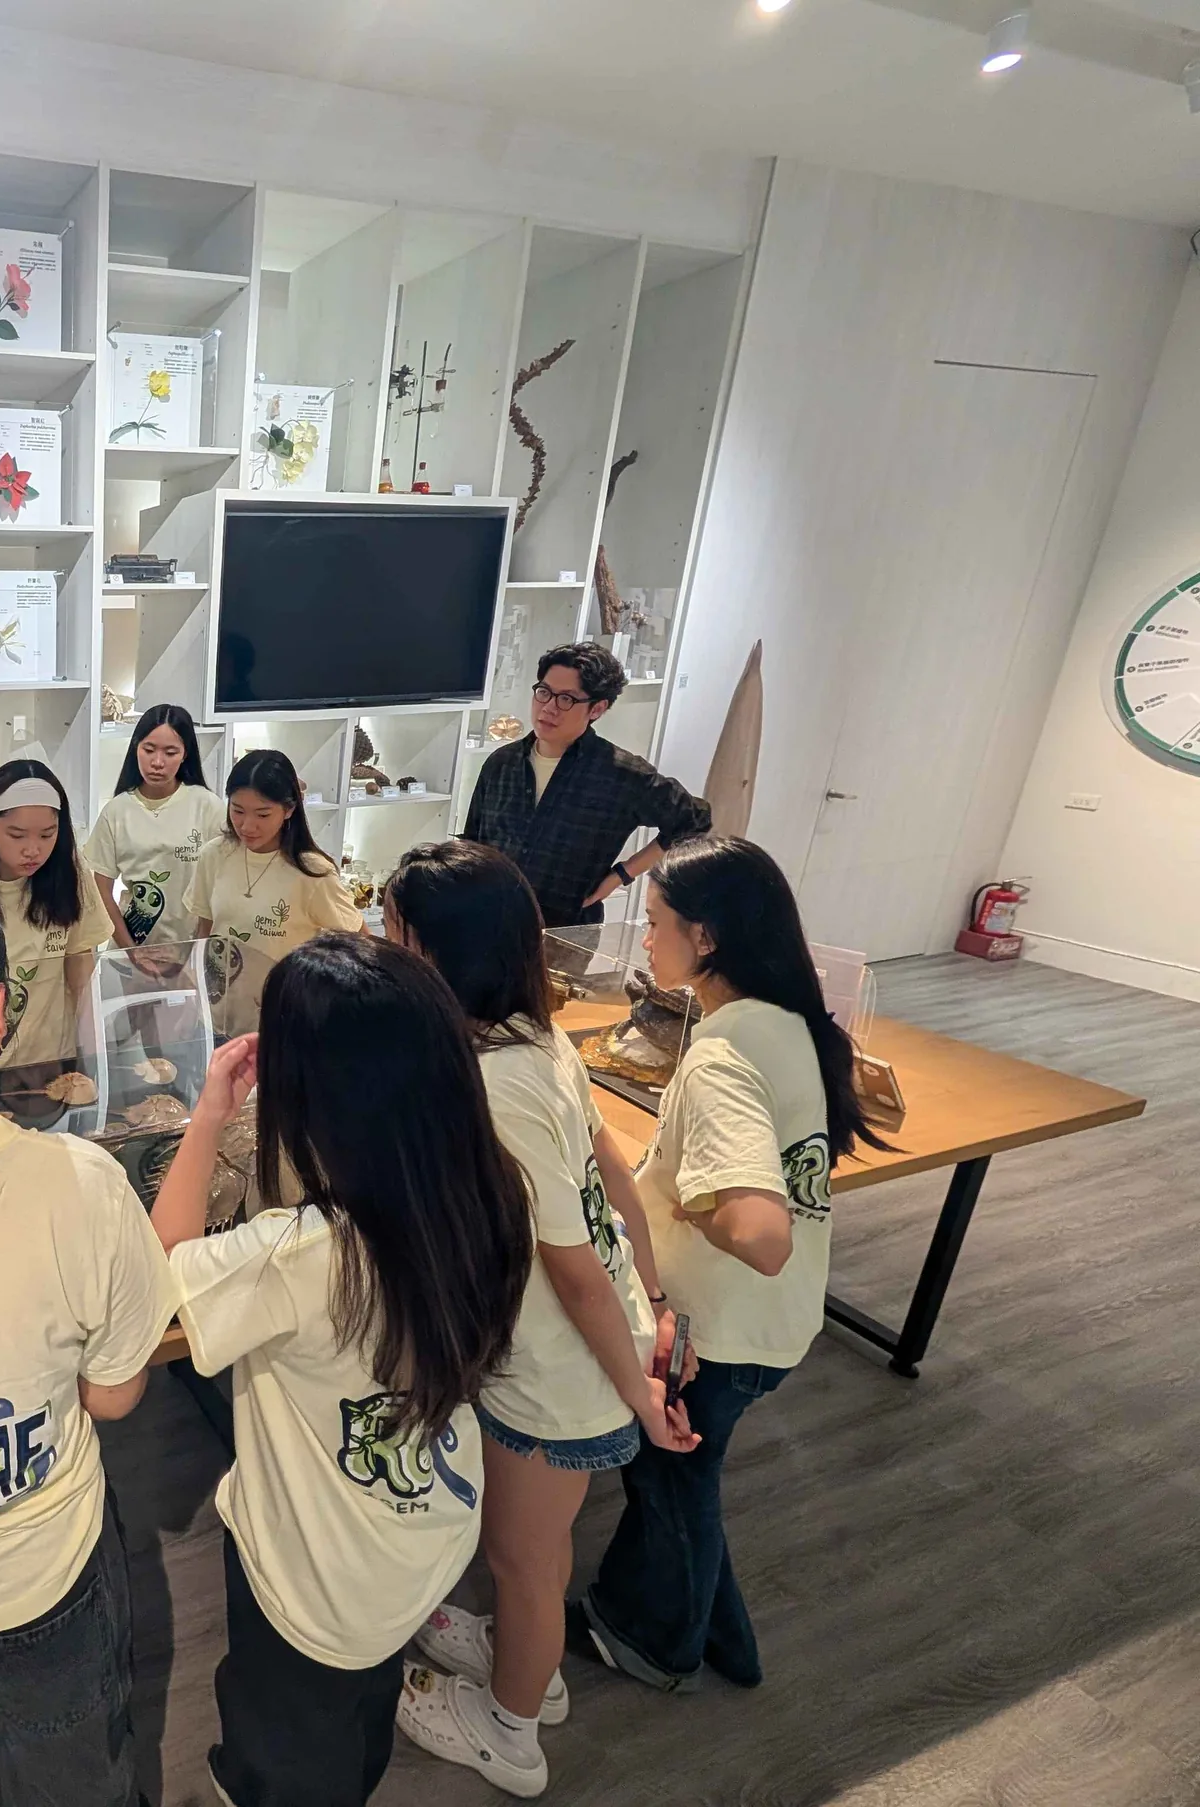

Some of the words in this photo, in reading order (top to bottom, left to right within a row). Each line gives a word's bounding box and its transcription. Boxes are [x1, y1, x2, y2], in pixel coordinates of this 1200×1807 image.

[175, 846, 195, 858] gems
[254, 915, 277, 928] gems
[259, 926, 287, 937] taiwan
